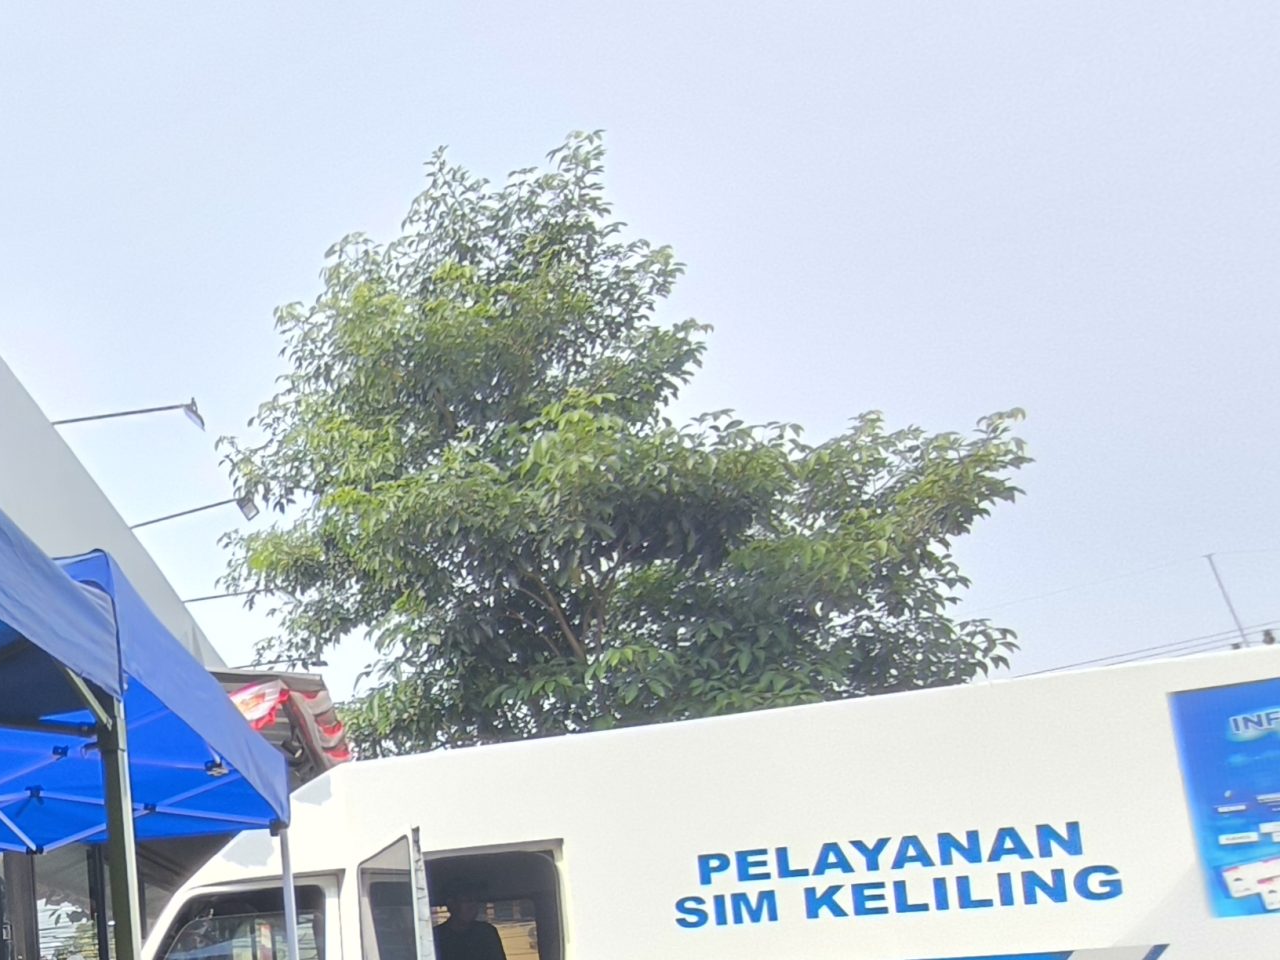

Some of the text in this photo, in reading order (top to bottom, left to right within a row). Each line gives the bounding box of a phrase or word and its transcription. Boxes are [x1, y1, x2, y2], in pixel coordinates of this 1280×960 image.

[697, 820, 1084, 885] PELAYANAN
[674, 863, 1124, 928] SIM KELILING
